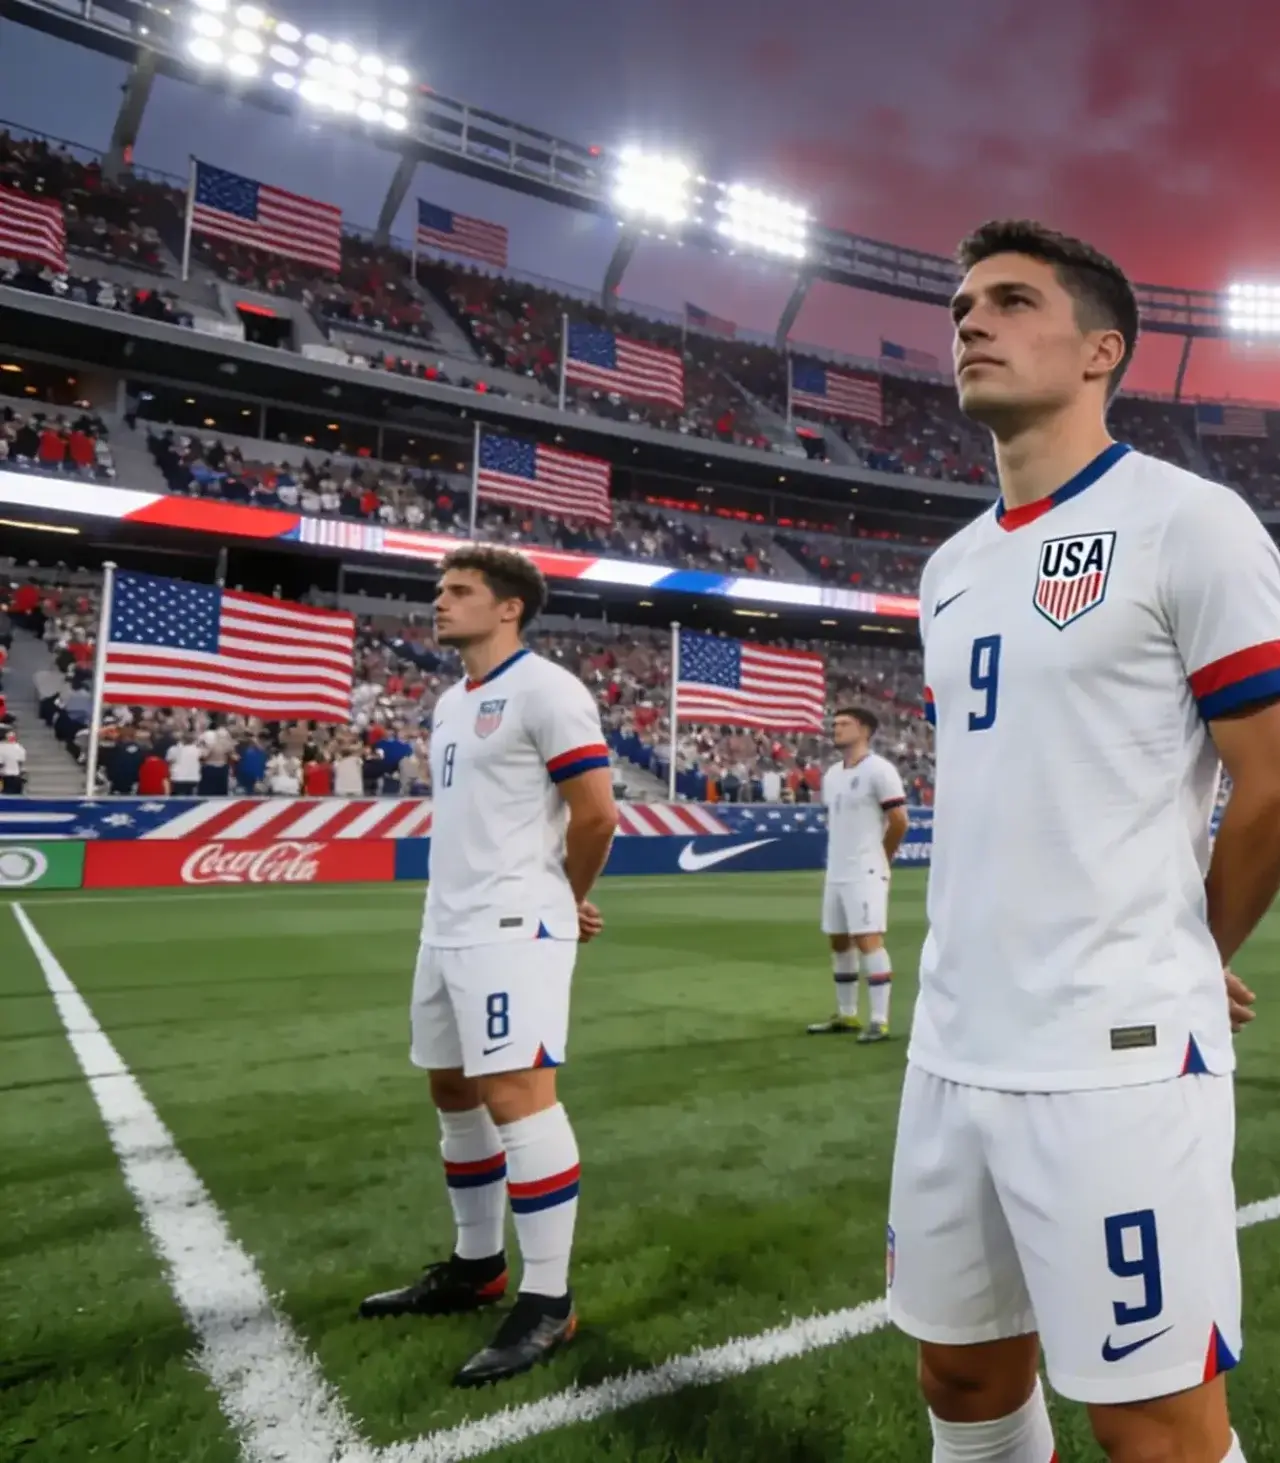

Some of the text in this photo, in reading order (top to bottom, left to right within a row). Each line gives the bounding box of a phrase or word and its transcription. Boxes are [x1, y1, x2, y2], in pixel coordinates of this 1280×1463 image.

[1042, 538, 1103, 577] USA
[968, 634, 1002, 731] 9
[486, 991, 509, 1040] 8
[1103, 1208, 1163, 1326] 9
